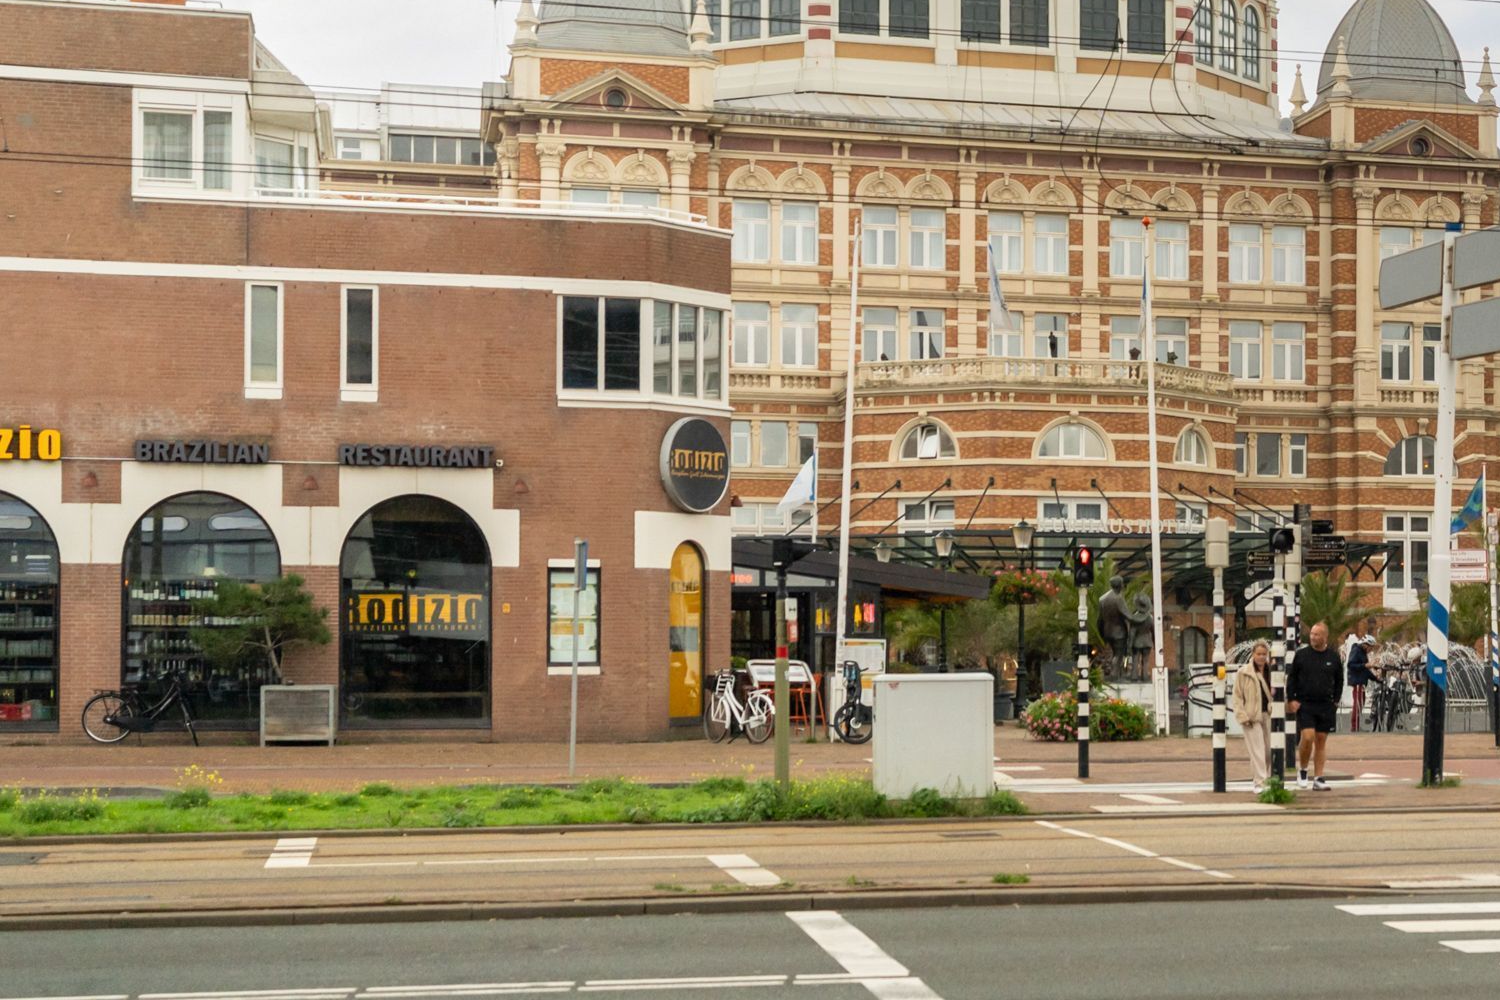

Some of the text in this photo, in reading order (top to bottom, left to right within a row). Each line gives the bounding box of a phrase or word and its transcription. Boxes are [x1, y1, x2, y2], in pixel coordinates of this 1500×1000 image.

[135, 439, 494, 467] BRAZILIAN RESTAURANT
[1137, 518, 1202, 534] HTEL
